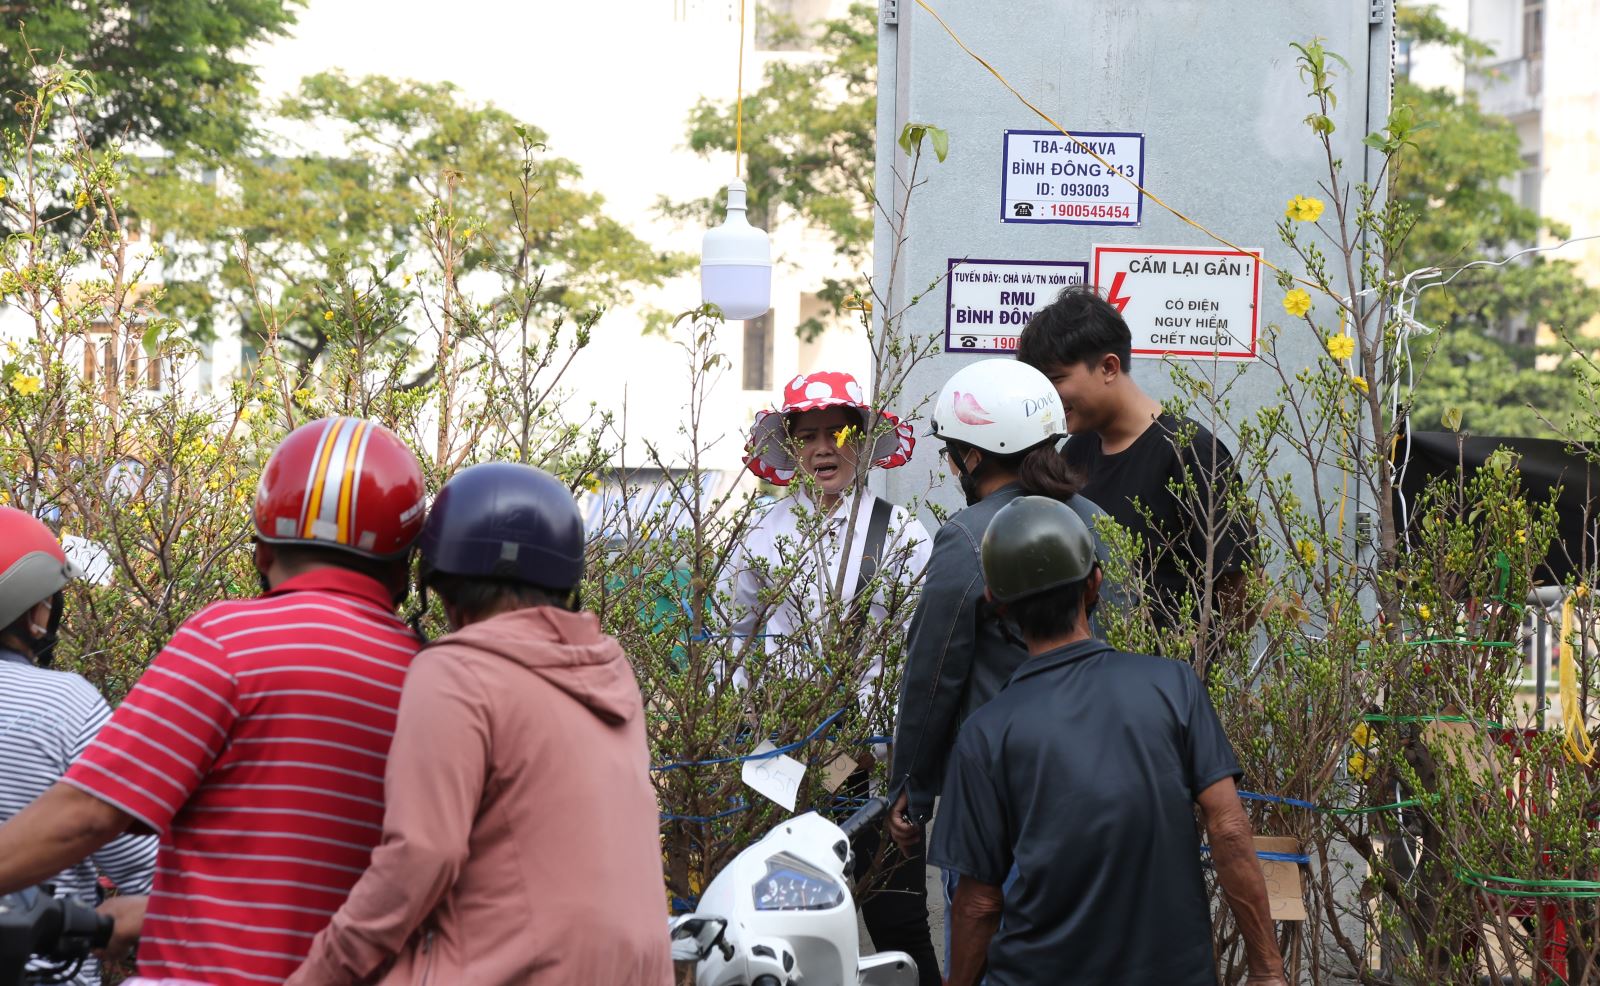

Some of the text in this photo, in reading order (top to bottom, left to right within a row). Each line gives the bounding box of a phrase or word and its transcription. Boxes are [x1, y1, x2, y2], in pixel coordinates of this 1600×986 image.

[1032, 140, 1116, 155] TBA-400KVA
[1012, 158, 1135, 178] BÌNH ĐÔNG 413
[1036, 182, 1110, 197] ID: 093003
[1050, 204, 1130, 219] 1900545454
[1129, 255, 1167, 274] CẤM
[1172, 261, 1199, 278] LẠI
[1204, 257, 1241, 276] GẦN
[982, 270, 1001, 283] DÂY:
[1003, 271, 1020, 284] CHÀ
[1021, 271, 1047, 285] VÀ/TN
[1048, 272, 1066, 285] XÓM
[1000, 291, 1035, 306] RMU
[1165, 297, 1219, 313] CÓ ĐIỆN
[956, 306, 1034, 325] BÌNH ĐÔN
[1154, 313, 1228, 329] NGUY HIỂM
[1150, 330, 1186, 345] CHẾT
[1022, 392, 1055, 418] Dove
